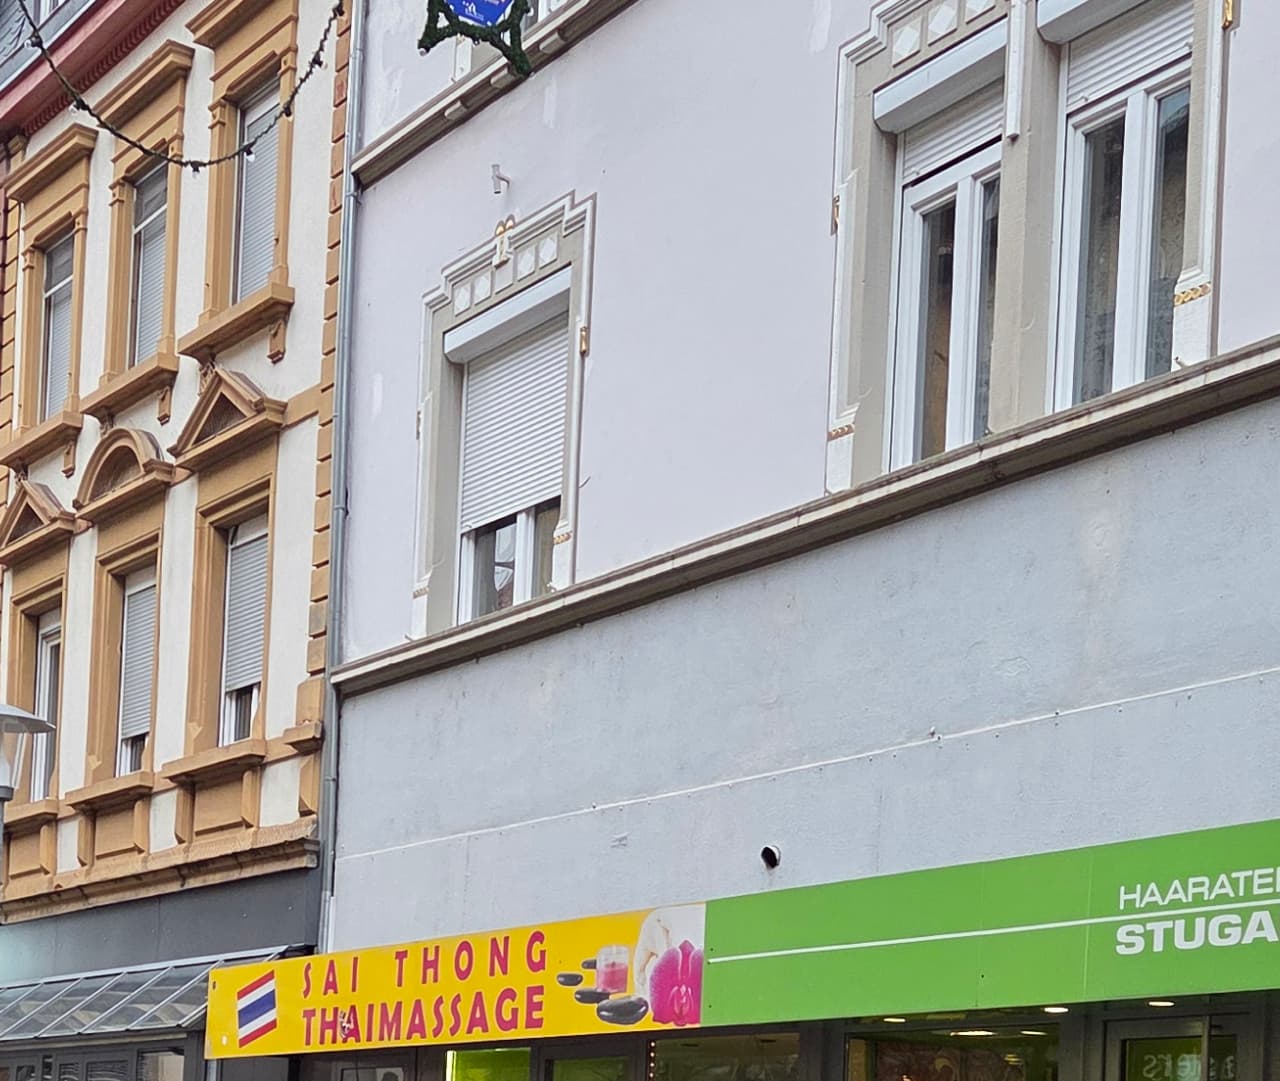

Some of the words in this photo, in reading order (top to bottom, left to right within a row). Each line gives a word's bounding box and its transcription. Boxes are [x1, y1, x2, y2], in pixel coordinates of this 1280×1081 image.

[302, 956, 359, 999] SAI
[394, 930, 547, 988] THONG
[302, 984, 545, 1046] THAIMASSAGE
